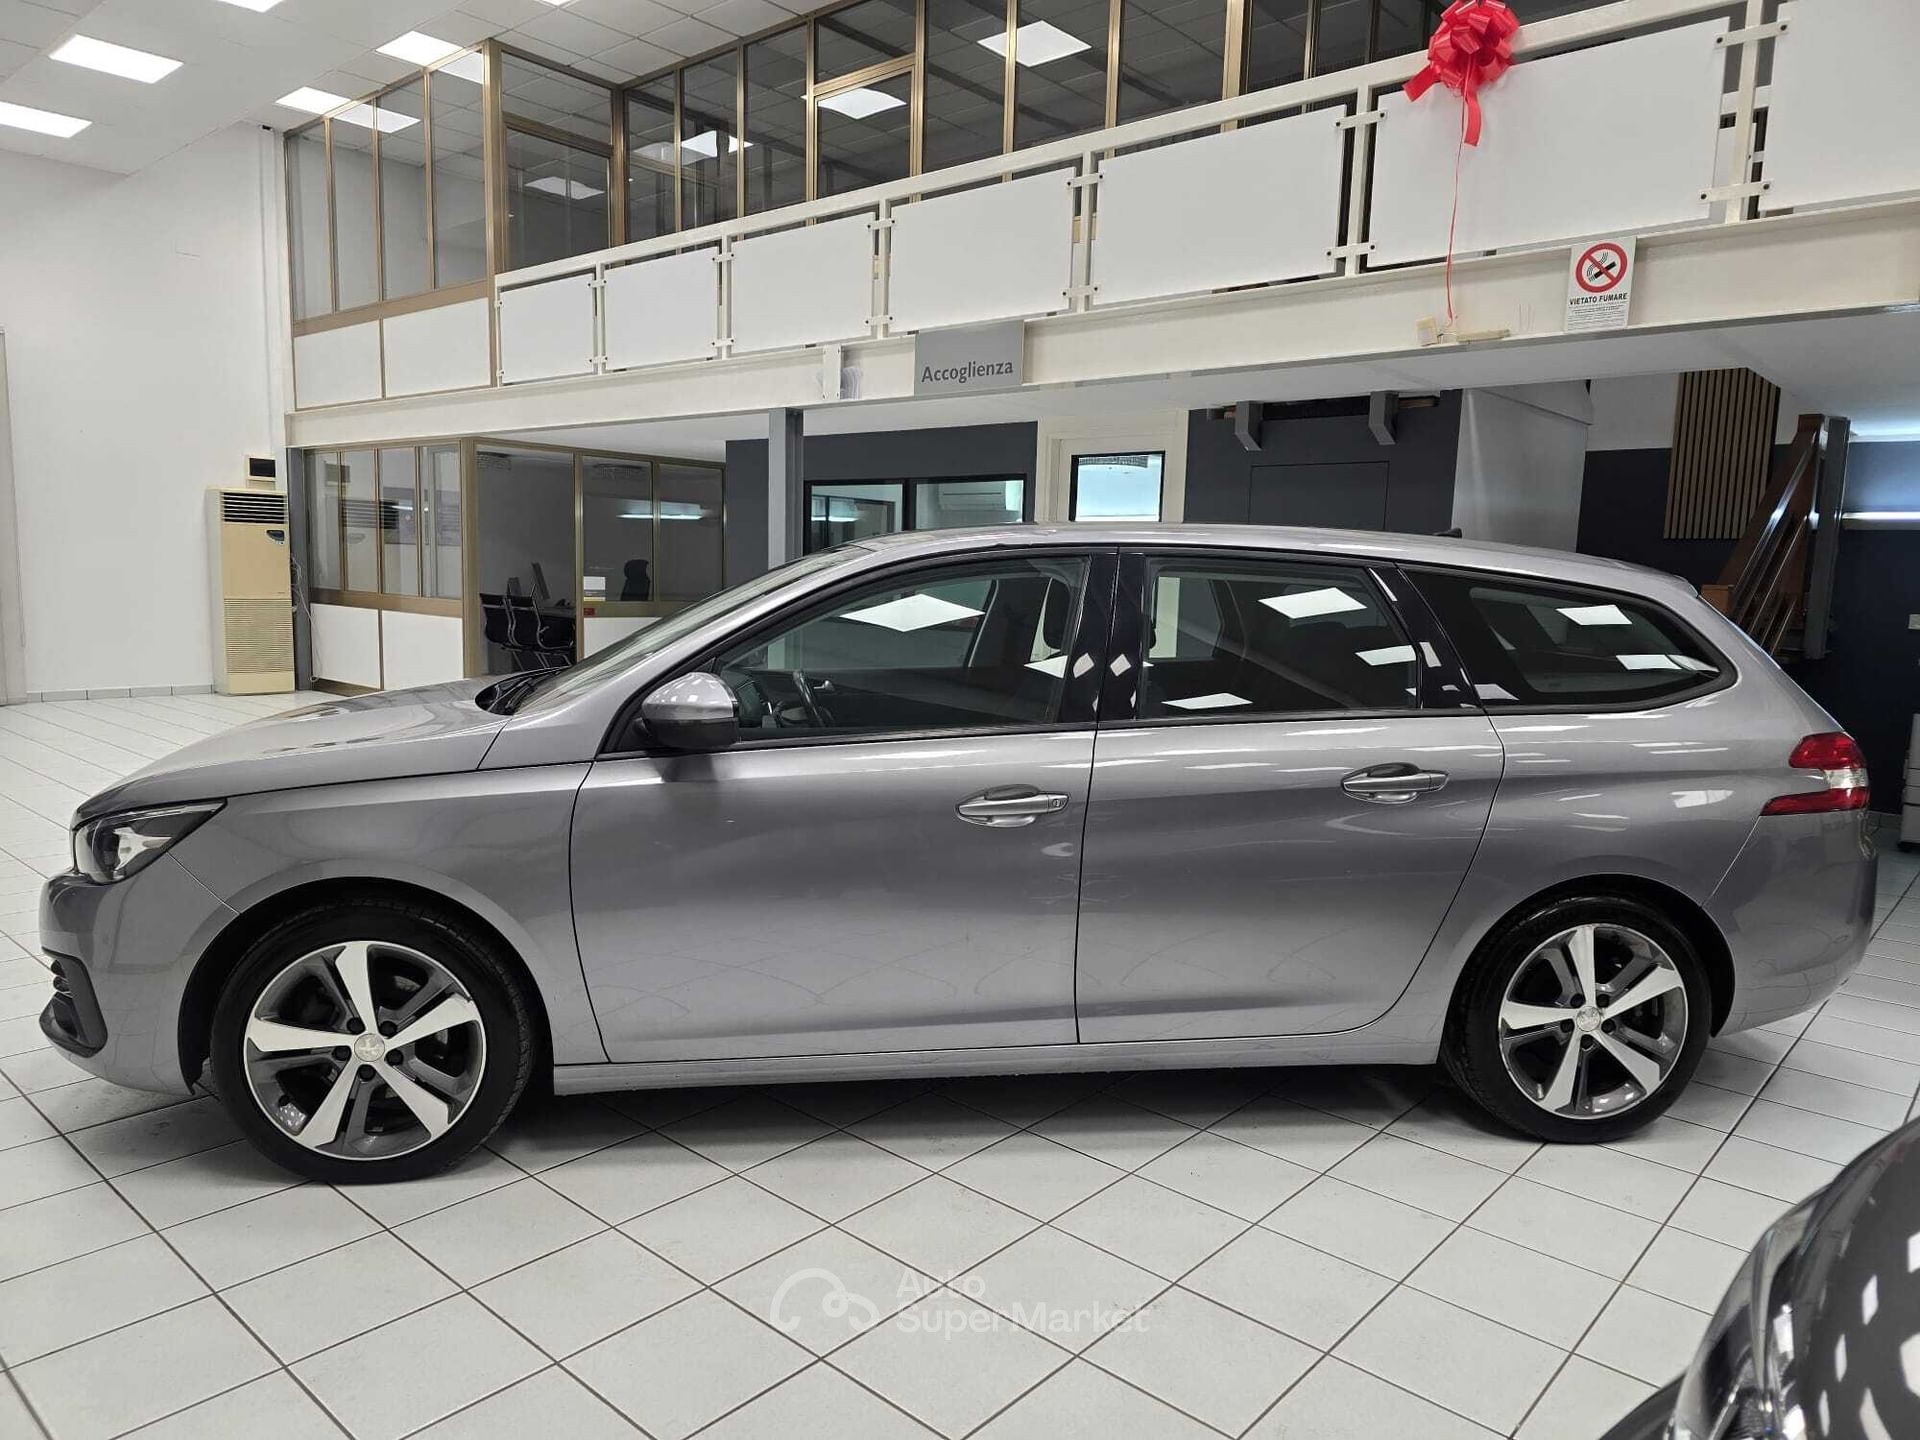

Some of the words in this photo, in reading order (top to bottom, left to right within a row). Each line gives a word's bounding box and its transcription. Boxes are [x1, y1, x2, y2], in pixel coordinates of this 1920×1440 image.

[1569, 296, 1597, 305] VIETATO
[1599, 292, 1628, 302] FUMARE
[921, 361, 1013, 383] Accoglienza
